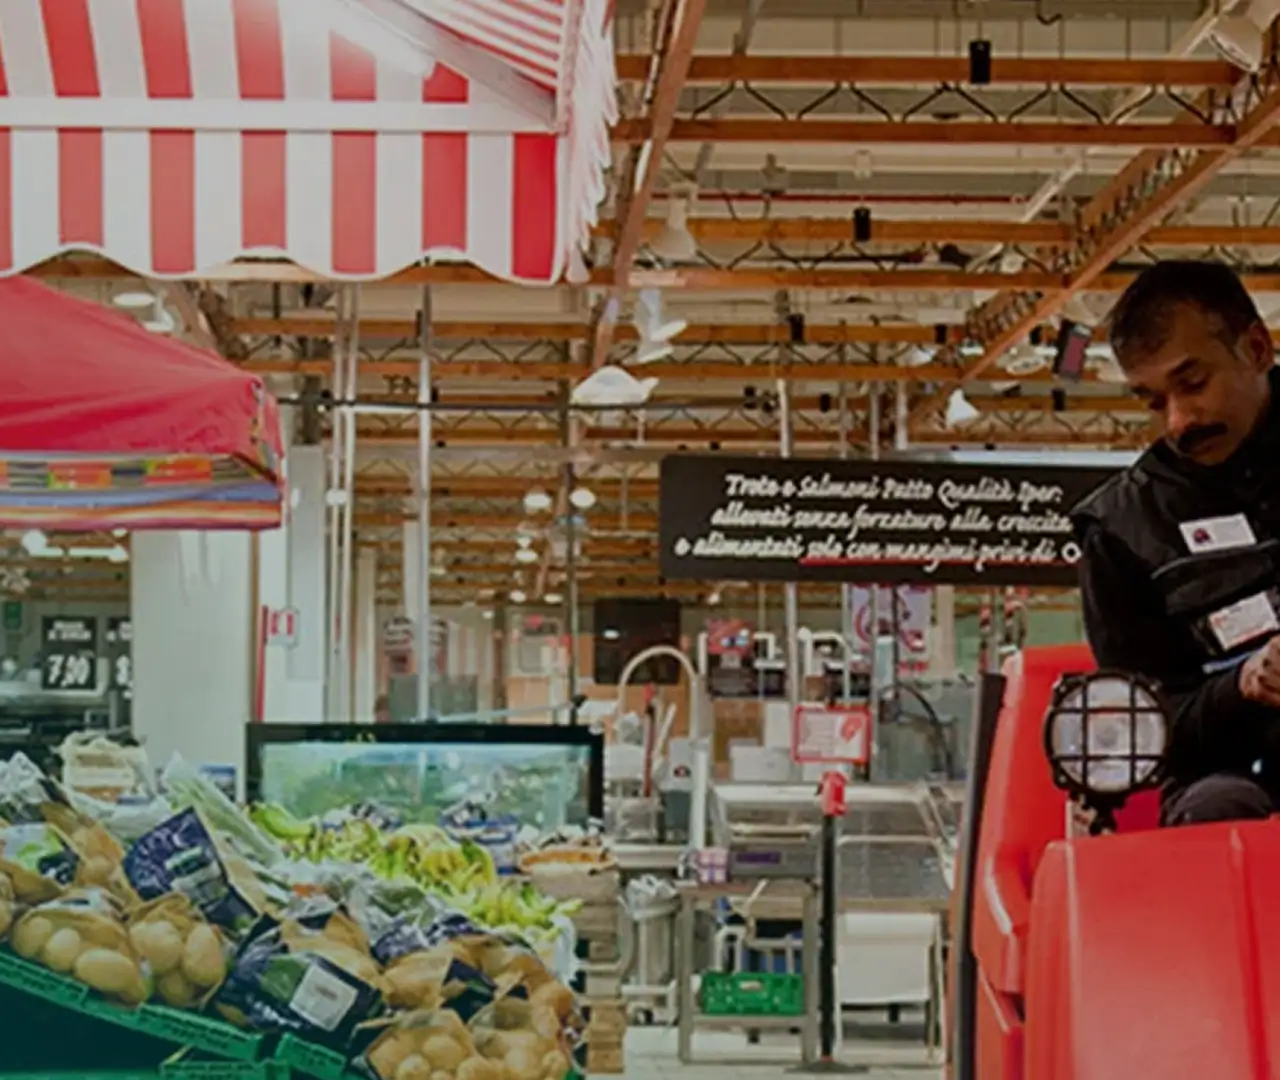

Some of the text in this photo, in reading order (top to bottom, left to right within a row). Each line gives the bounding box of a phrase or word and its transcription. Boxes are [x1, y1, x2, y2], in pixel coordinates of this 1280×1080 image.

[725, 472, 780, 497] Trote
[797, 472, 880, 499] Salmoni
[883, 477, 934, 500] Patto
[938, 476, 1016, 510] Qualità
[710, 500, 1074, 541] allevati senza forzature alla crescita
[674, 537, 691, 557] e
[692, 530, 805, 559] alimentati
[807, 533, 844, 559] solo
[846, 542, 881, 560] con
[885, 537, 975, 573] mangimi
[975, 537, 1028, 572] privi
[1029, 537, 1058, 562] di
